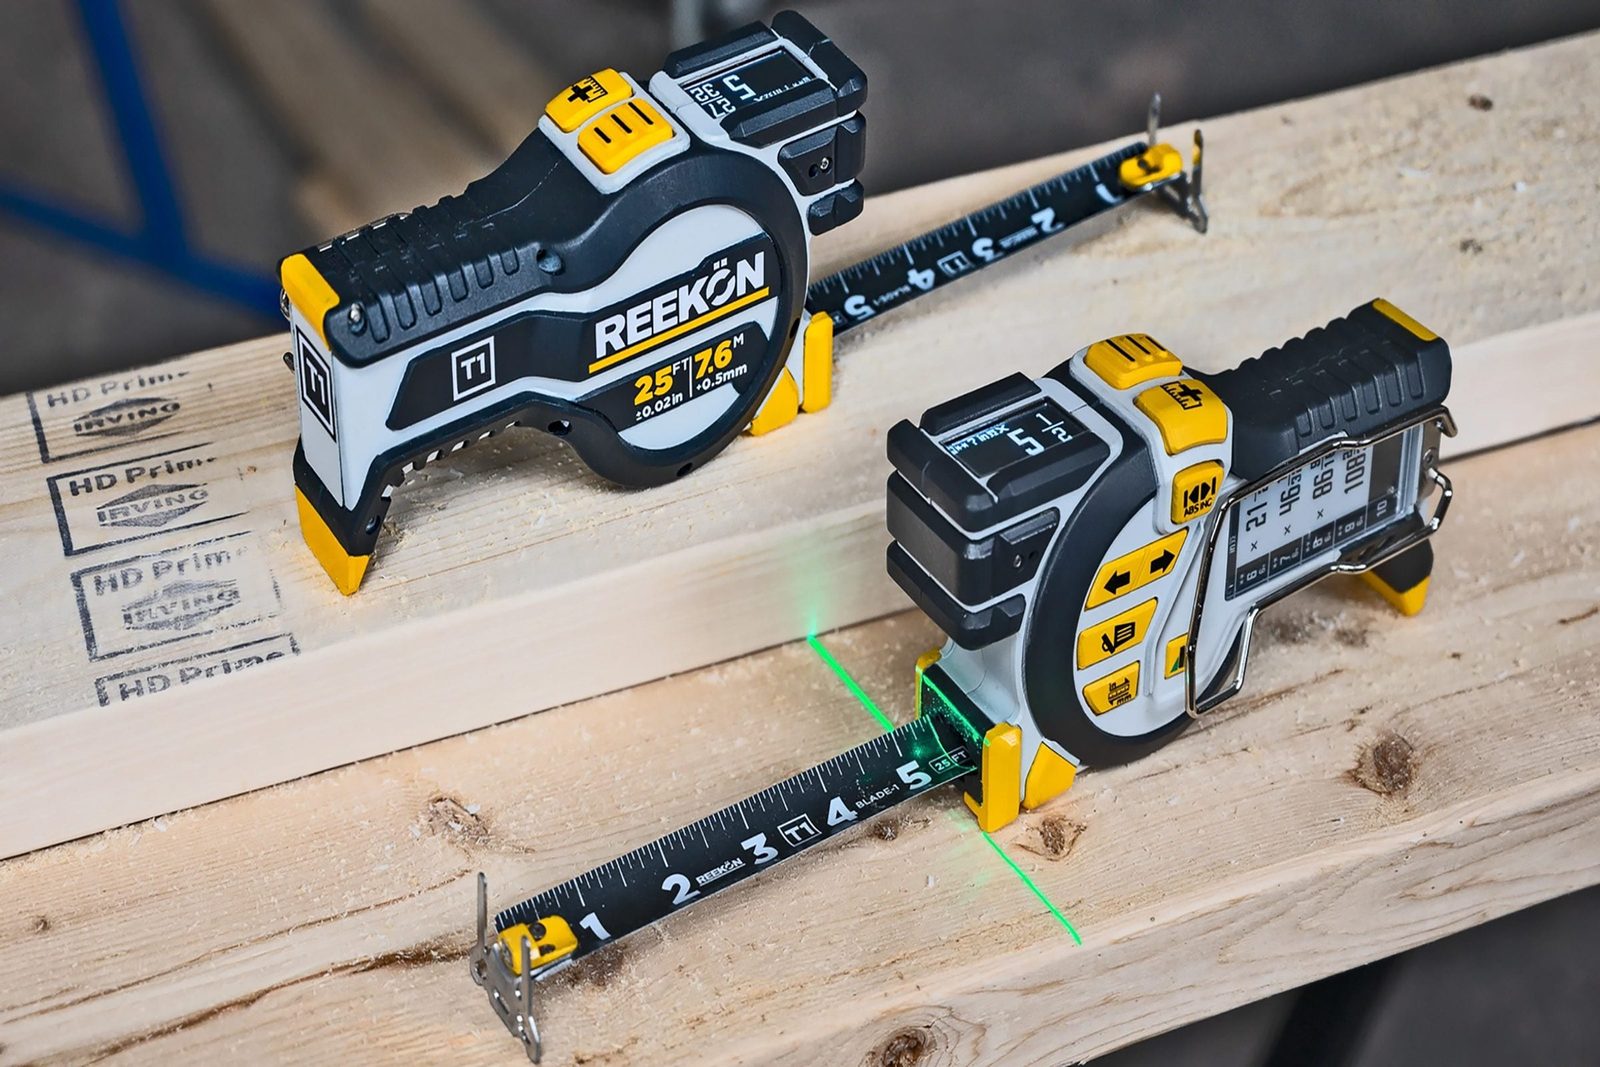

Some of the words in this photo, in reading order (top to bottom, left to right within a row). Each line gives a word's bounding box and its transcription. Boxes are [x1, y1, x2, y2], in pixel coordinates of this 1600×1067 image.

[722, 75, 756, 100] 5
[1031, 206, 1065, 233] 2
[971, 237, 1004, 262] 3
[907, 268, 935, 291] 4
[844, 294, 876, 320] 5
[461, 352, 485, 380] T1
[694, 339, 733, 380] 7.6
[306, 357, 326, 405] T1
[634, 366, 673, 406] 25
[47, 388, 91, 407] HD
[74, 402, 180, 432] IRVING
[1007, 428, 1045, 456] 5
[69, 474, 117, 496] HD
[1312, 468, 1334, 500] 86
[1344, 452, 1366, 494] 108
[97, 489, 208, 522] IRVING
[1279, 484, 1301, 517] 46
[1376, 500, 1388, 517] 10
[1246, 502, 1268, 532] 21
[94, 567, 144, 596] HD
[152, 546, 242, 579] Prim
[123, 589, 241, 625] IRVING
[119, 674, 171, 701] HD
[935, 759, 951, 771] 25
[951, 750, 967, 762] FT
[896, 760, 932, 791] 5
[855, 783, 900, 809] BLADE-1
[827, 796, 858, 827] 4
[784, 821, 815, 841] T1
[740, 832, 779, 865] 3
[661, 873, 701, 906] 2
[579, 912, 611, 940] 1
